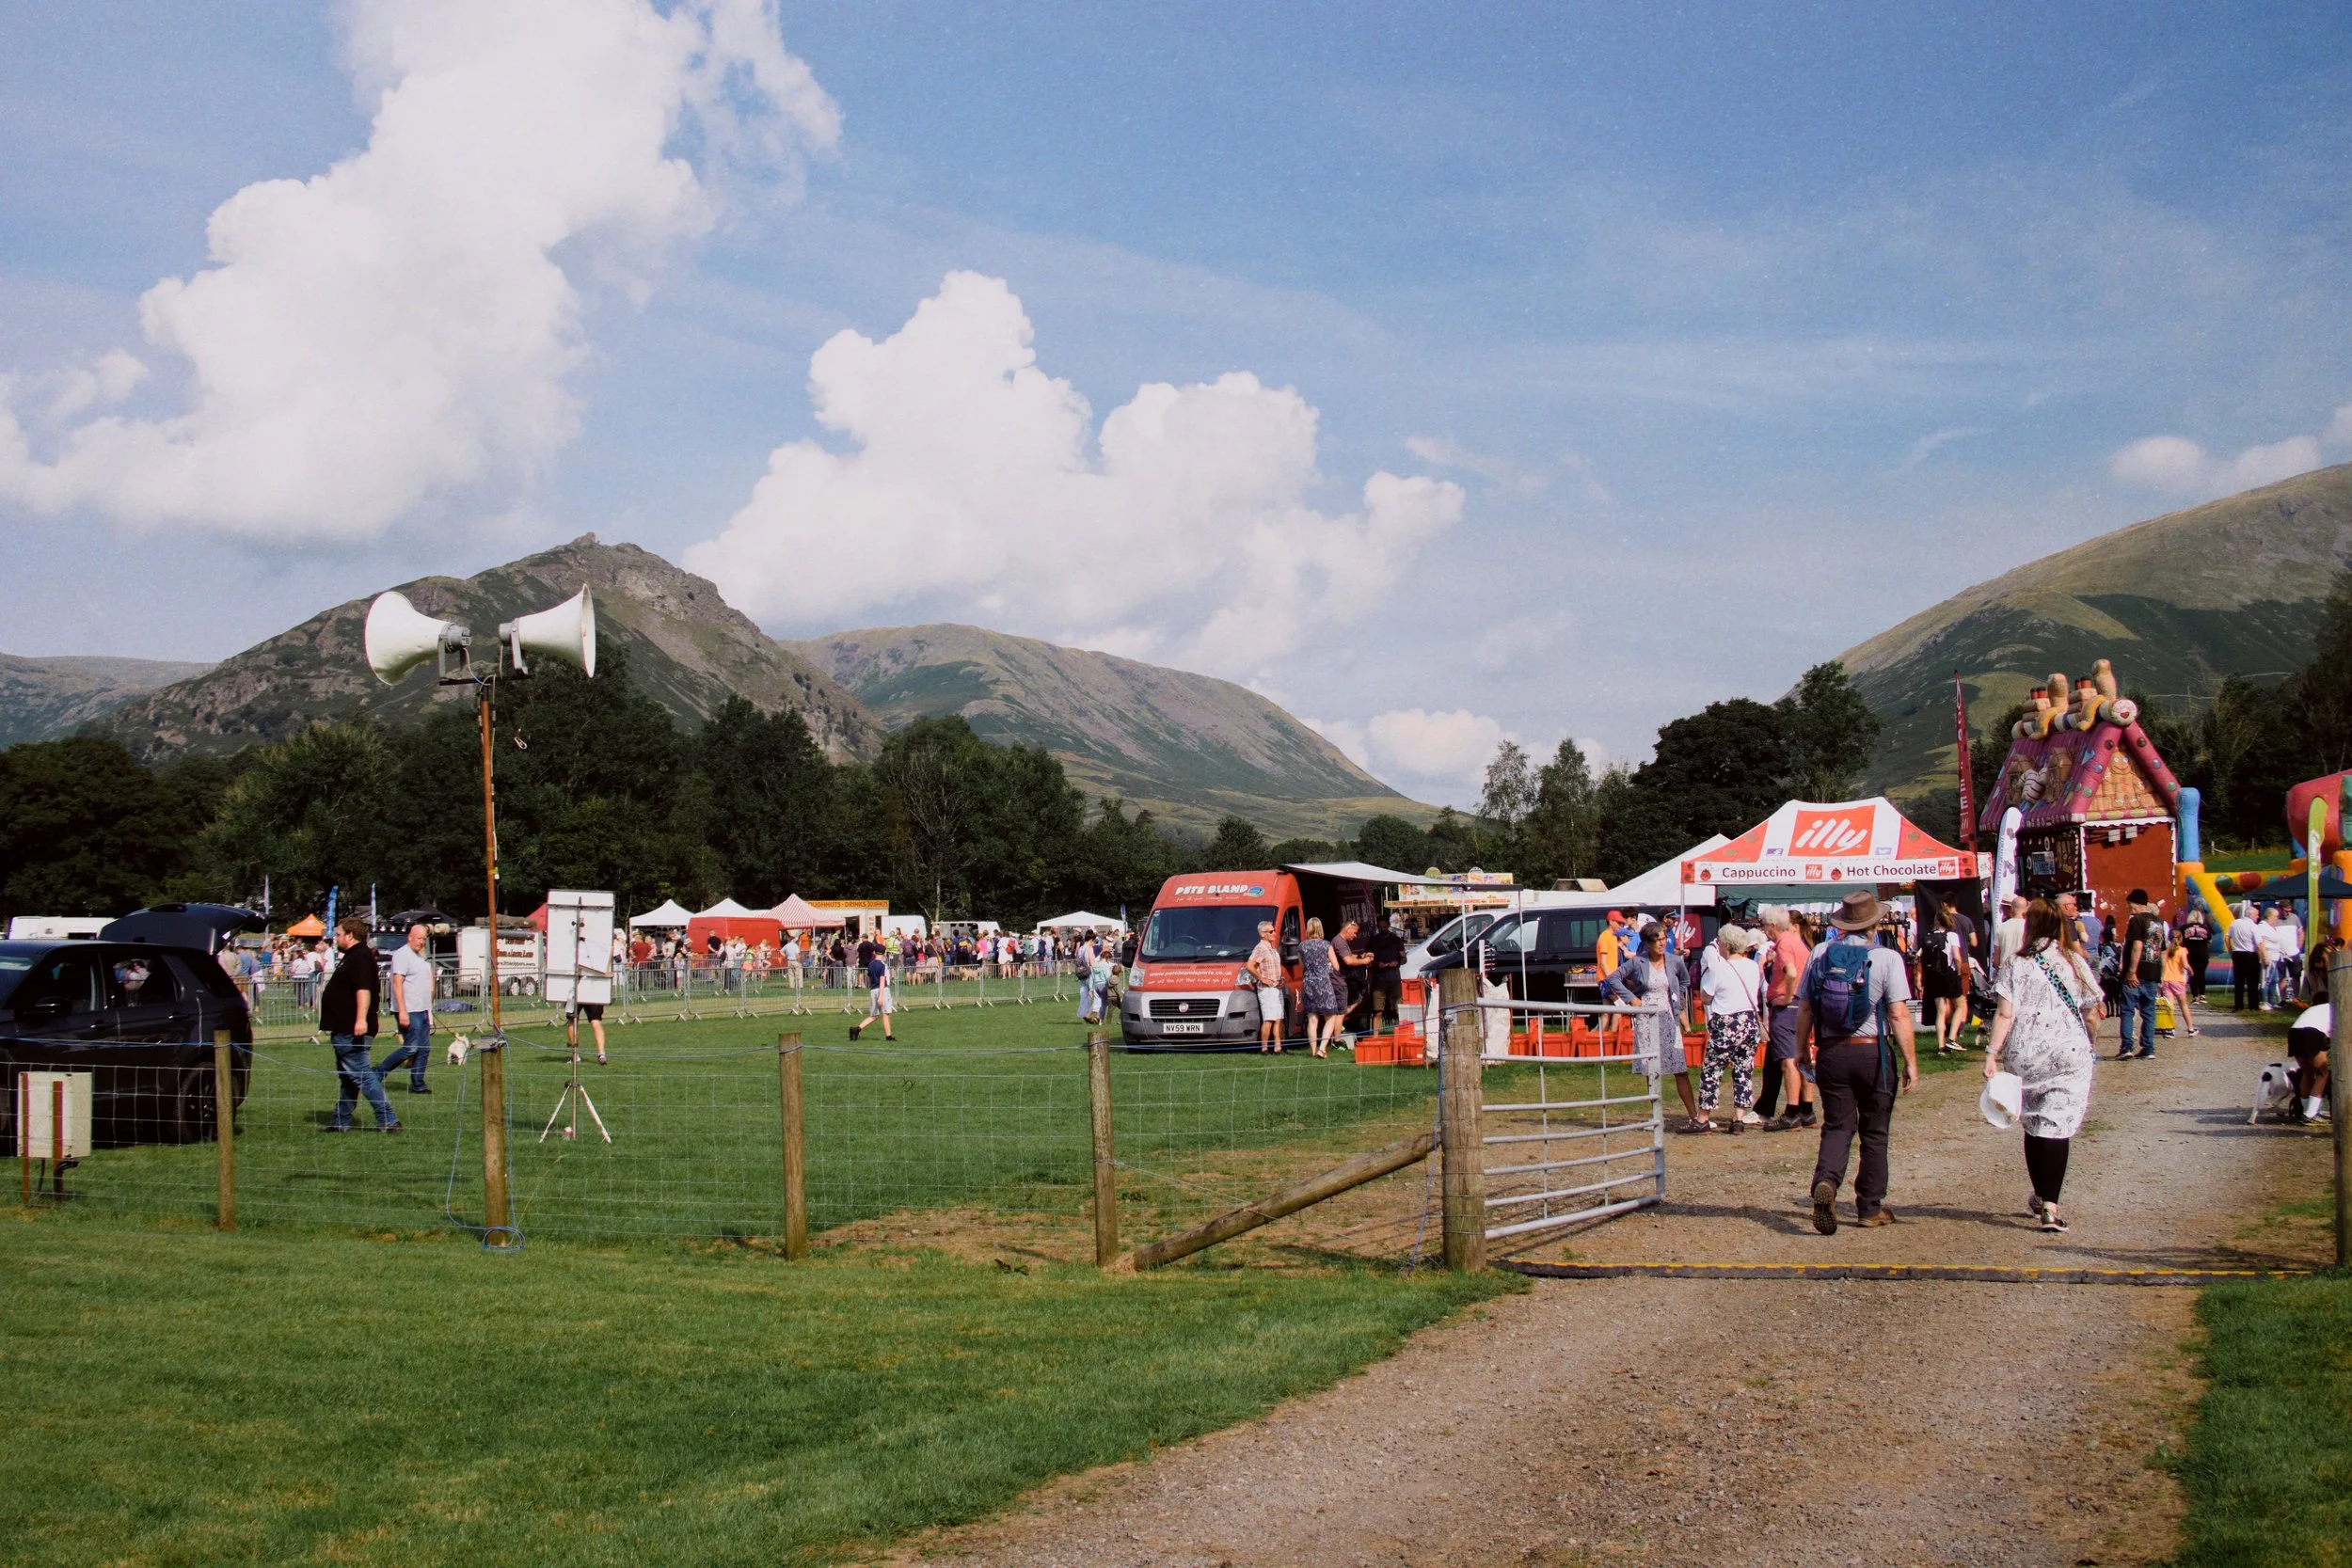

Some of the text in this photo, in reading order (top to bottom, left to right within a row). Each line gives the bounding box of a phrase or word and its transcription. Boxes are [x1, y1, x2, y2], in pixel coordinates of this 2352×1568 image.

[1795, 817, 1867, 855] illy
[1722, 861, 1955, 879] Cappuccino illy Hot Chocolate illy
[1174, 885, 1205, 895] PETE
[1207, 884, 1248, 895] BLAND
